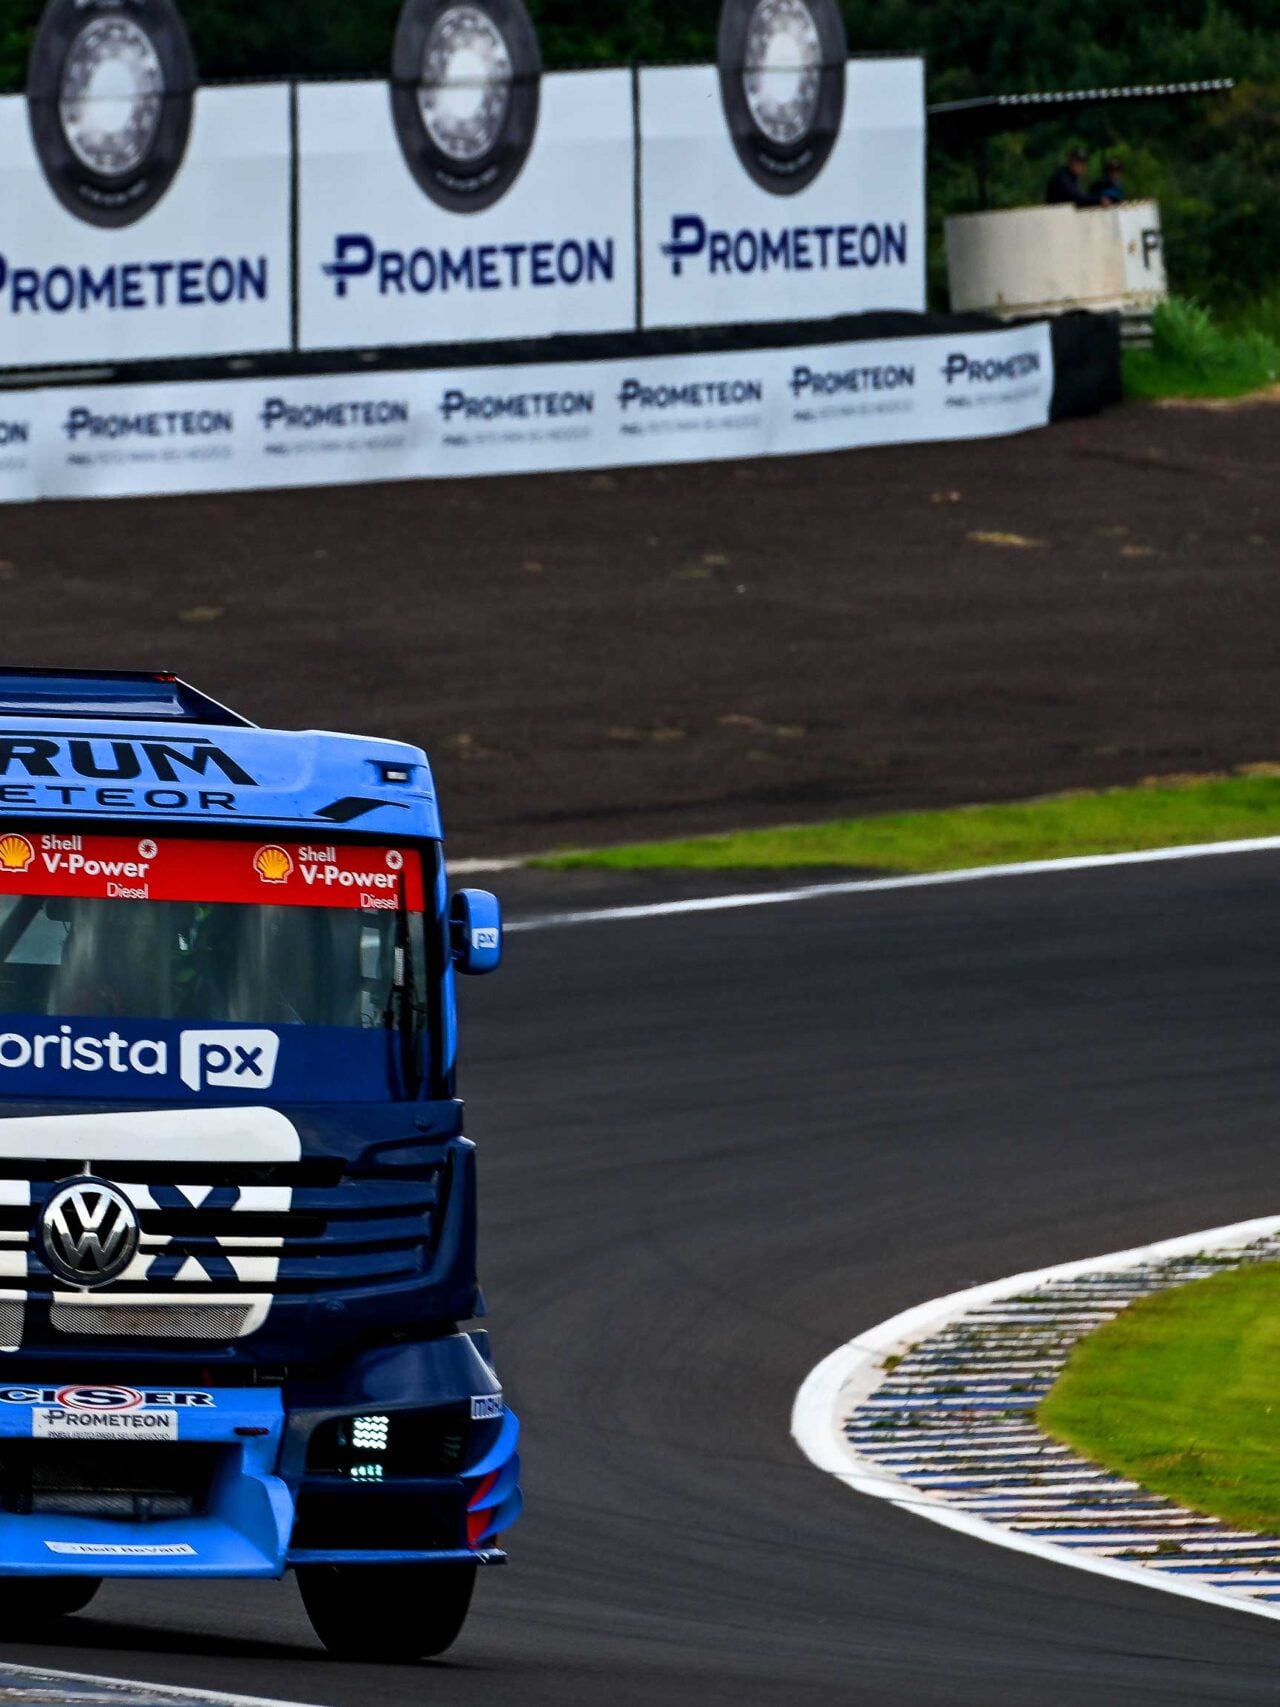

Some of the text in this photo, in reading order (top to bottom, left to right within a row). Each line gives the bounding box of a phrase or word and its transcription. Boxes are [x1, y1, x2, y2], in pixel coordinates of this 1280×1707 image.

[661, 214, 908, 277] PROMETEON
[323, 233, 615, 298] PROMETEON
[617, 379, 763, 410] PROMETEON
[789, 366, 915, 402] PROMETEON
[260, 398, 408, 431] PROMETEON
[438, 389, 593, 422] PROMETEON
[62, 406, 233, 440] PROMETEON
[41, 835, 82, 851] Shell
[299, 846, 336, 863] Shell
[41, 852, 149, 878] V-Power
[299, 864, 398, 889] V-Power
[107, 882, 149, 899] Diesel
[361, 892, 398, 910] Diesel
[43, 1410, 169, 1428] PROMETEON
